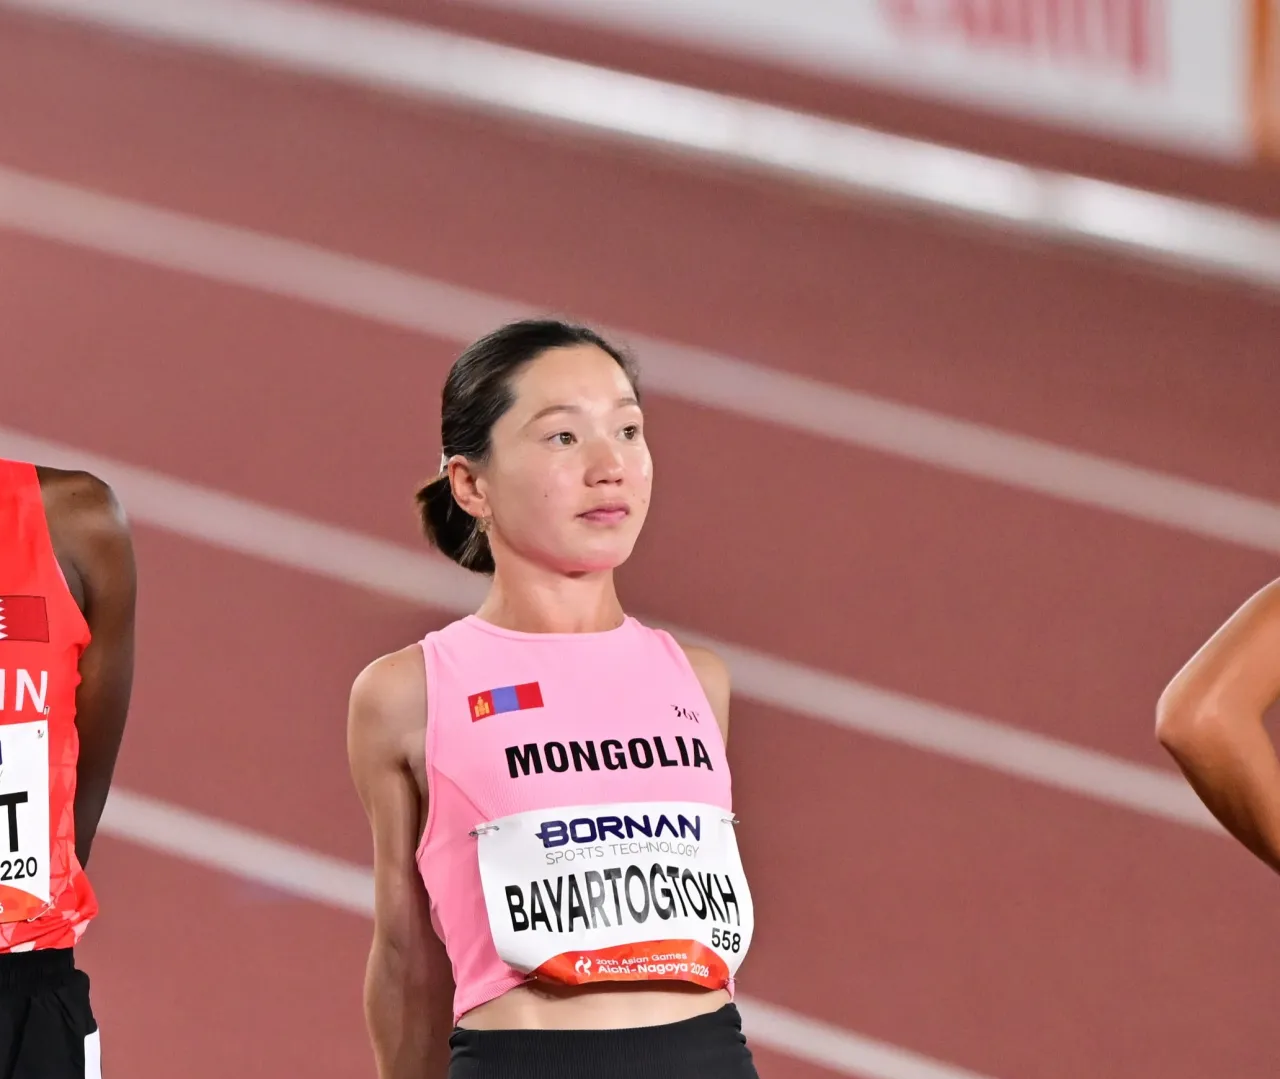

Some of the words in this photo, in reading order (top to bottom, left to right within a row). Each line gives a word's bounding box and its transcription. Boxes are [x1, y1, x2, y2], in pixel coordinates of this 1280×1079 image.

[505, 735, 714, 779] MONGOLIA
[536, 814, 701, 848] BORNAN
[546, 846, 604, 865] SPORTS
[610, 840, 700, 859] TECHNOLOGY
[0, 856, 39, 881] 220
[505, 863, 741, 933] BAYARTOGTOKH
[711, 927, 741, 953] 558
[596, 957, 618, 966] 20th
[620, 955, 649, 965] Asian
[651, 952, 687, 963] Games
[597, 961, 689, 975] Aichi-Nagoya
[691, 963, 709, 977] 2026
